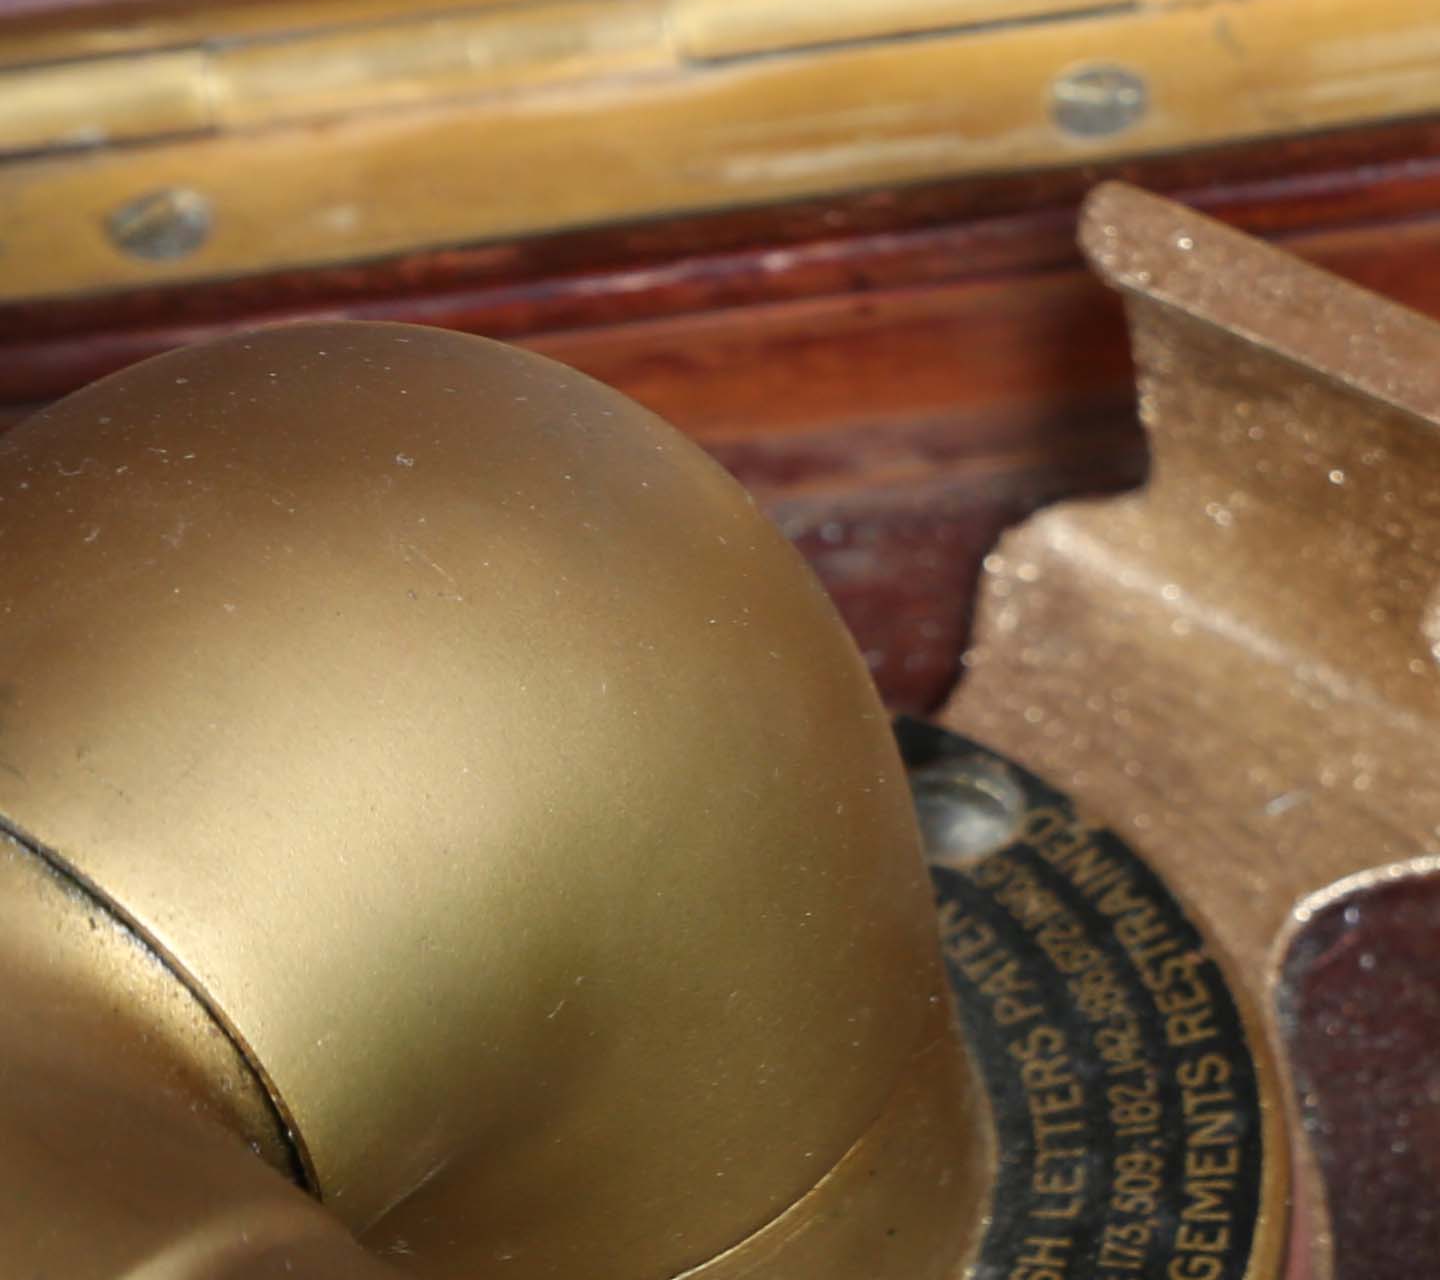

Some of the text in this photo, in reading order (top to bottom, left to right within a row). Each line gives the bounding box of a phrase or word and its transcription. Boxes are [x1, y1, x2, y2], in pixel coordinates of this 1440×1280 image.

[938, 900, 1044, 1025] PATEN
[1023, 808, 1216, 1047] RESTRAINED
[1006, 1024, 1088, 1219] LETTERS
